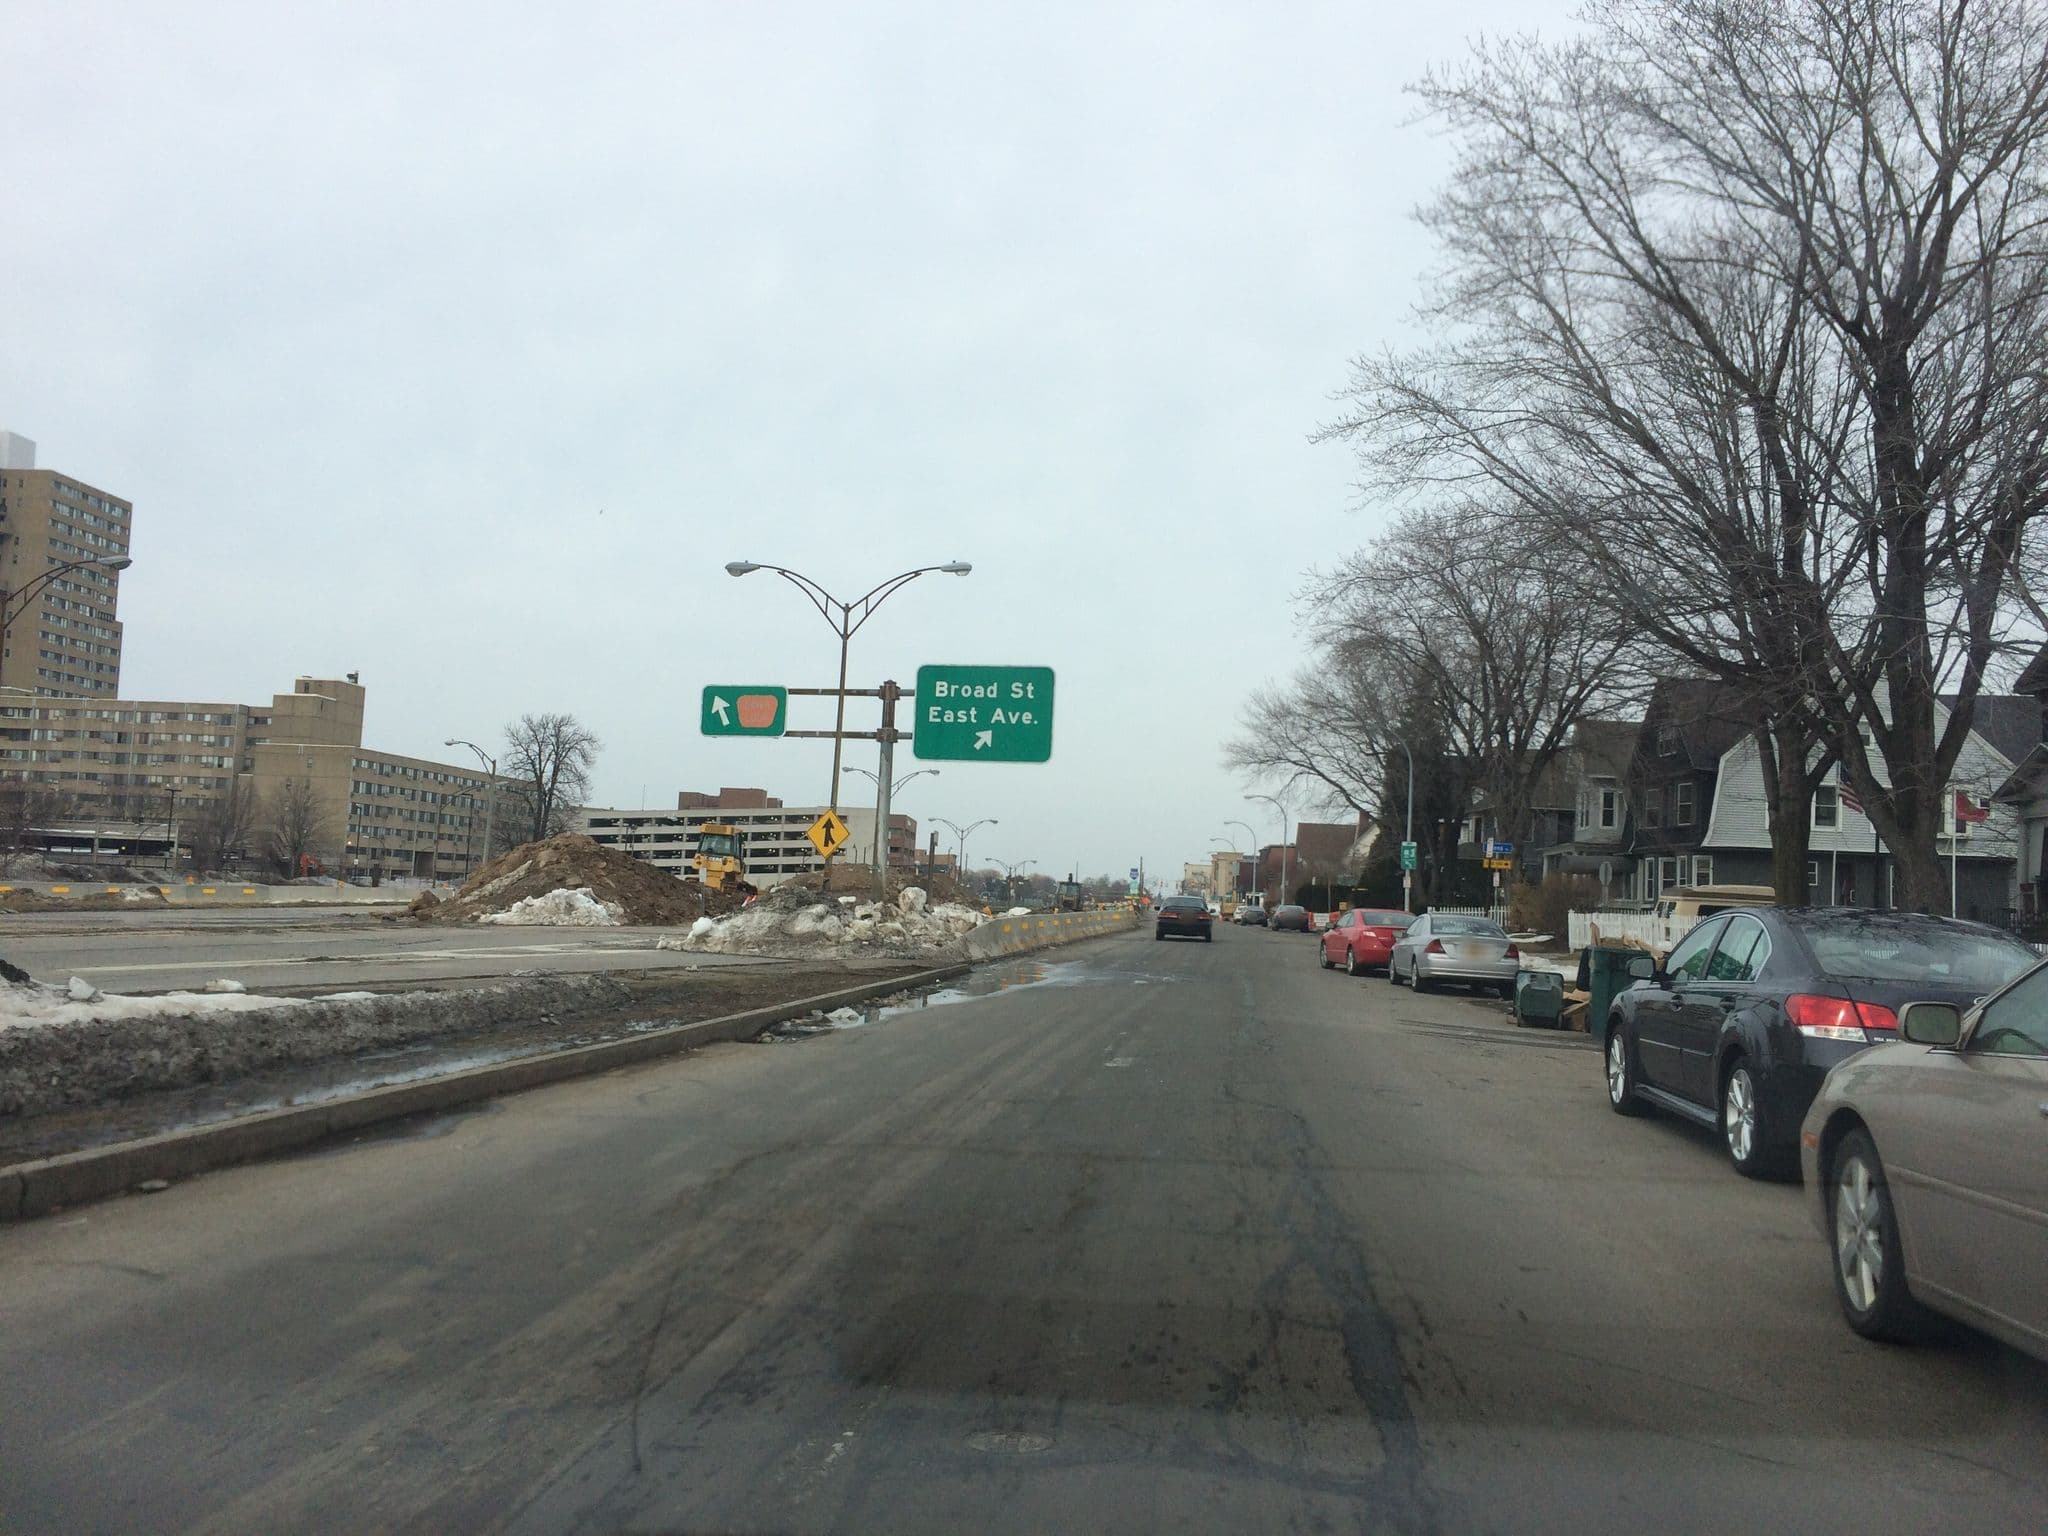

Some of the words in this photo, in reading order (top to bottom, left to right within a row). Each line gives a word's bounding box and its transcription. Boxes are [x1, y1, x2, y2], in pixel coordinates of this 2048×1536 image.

[935, 681, 998, 698] Broad
[1010, 682, 1034, 699] St
[928, 706, 977, 723] East
[990, 707, 1038, 724] Ave.
